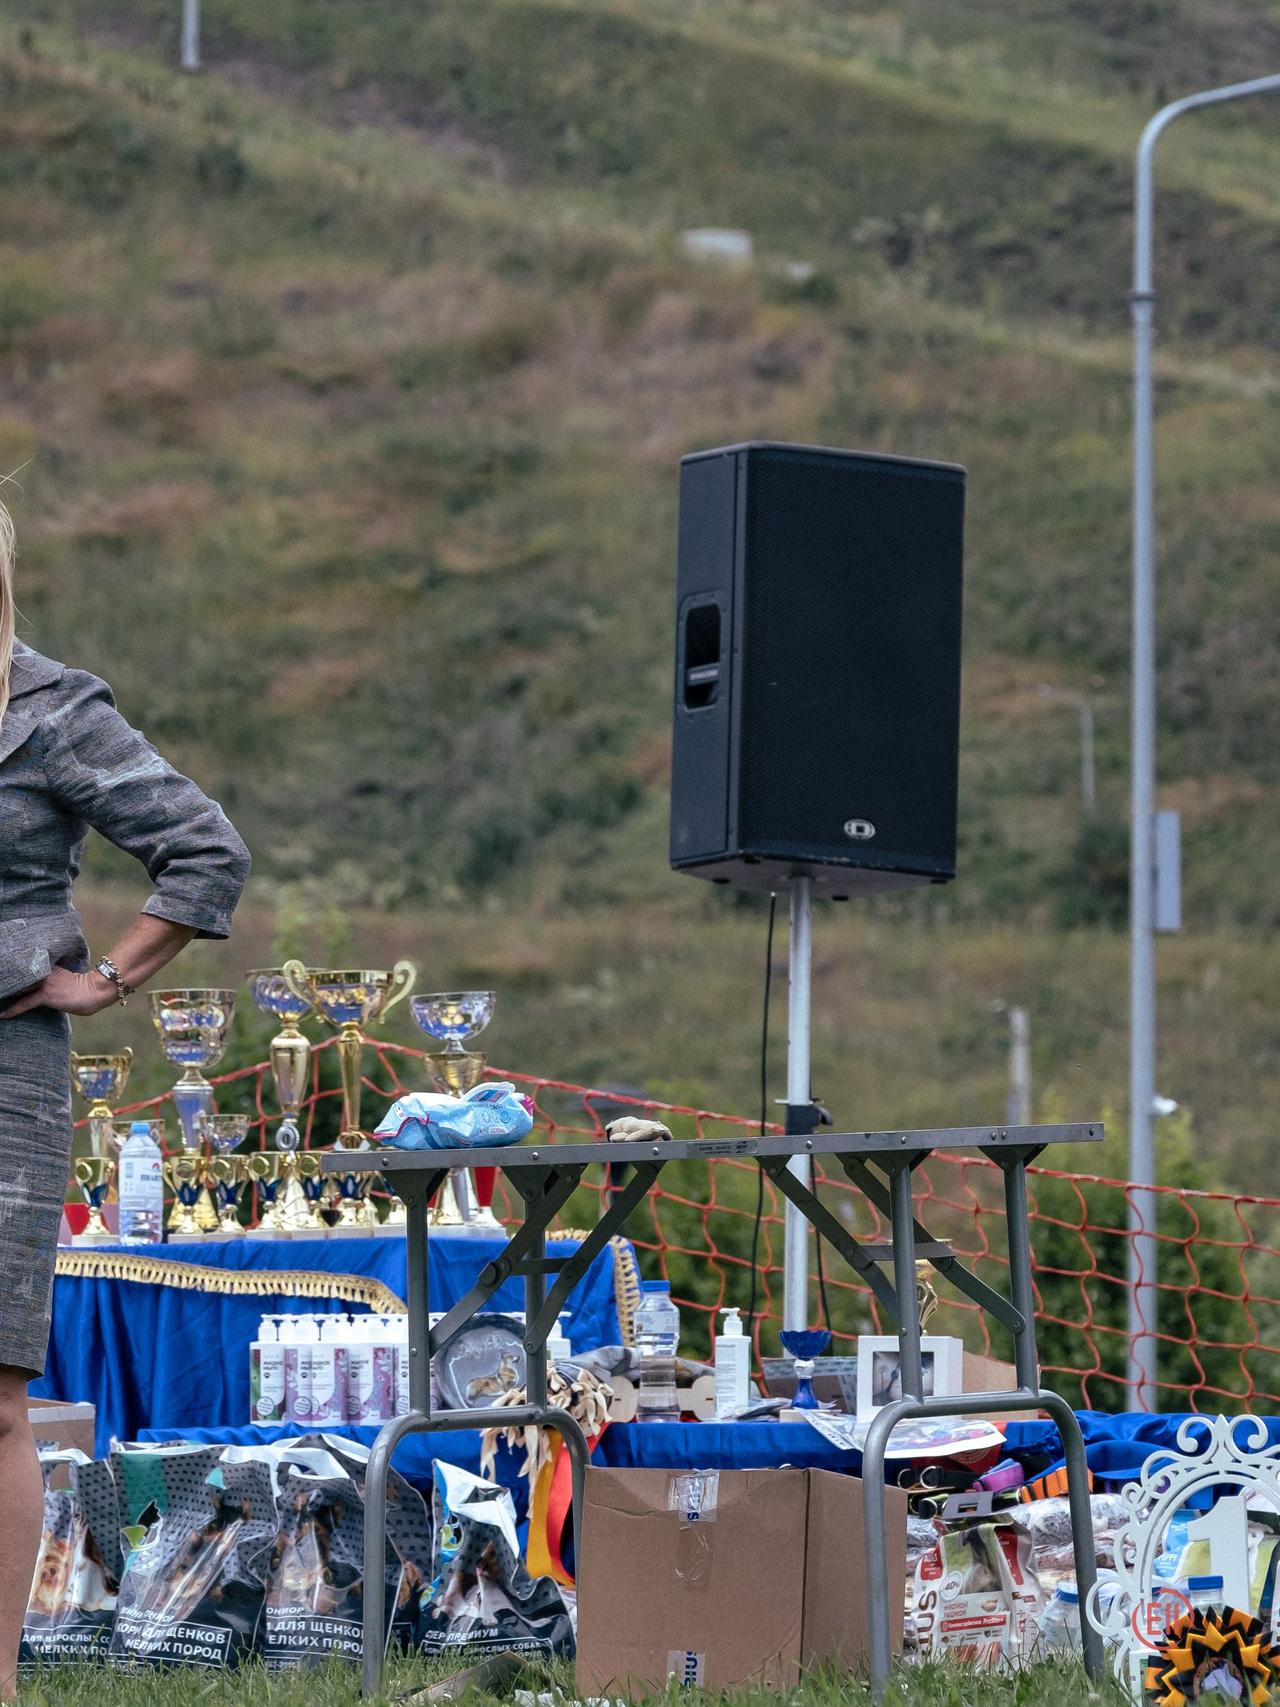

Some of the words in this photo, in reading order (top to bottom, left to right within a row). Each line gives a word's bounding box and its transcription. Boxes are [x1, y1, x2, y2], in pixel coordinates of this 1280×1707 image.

[275, 1620, 306, 1632] ДЛЯ
[310, 1622, 363, 1638] ЩЕНКО
[22, 1634, 43, 1643] ДЛЯ
[268, 1635, 319, 1648] ЕЛКИХ
[125, 1638, 171, 1653] МЕЛКИХ
[173, 1642, 222, 1660] ПОРОД
